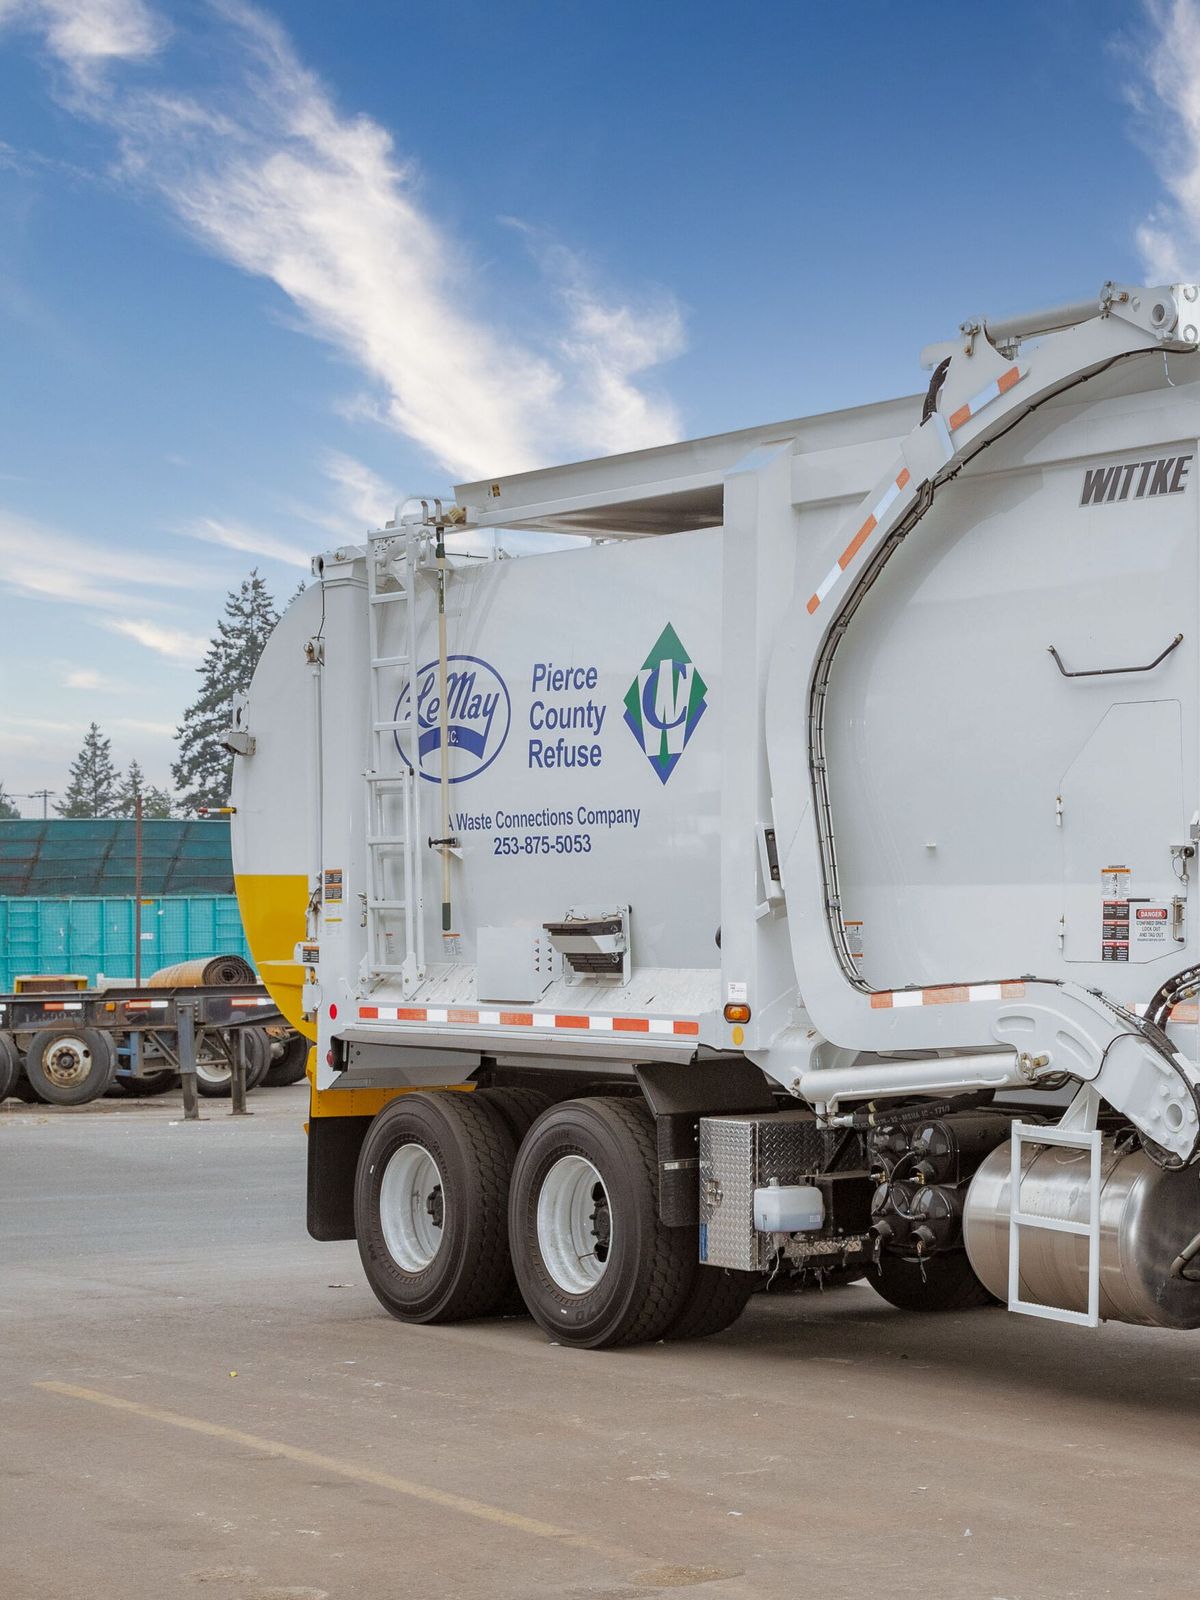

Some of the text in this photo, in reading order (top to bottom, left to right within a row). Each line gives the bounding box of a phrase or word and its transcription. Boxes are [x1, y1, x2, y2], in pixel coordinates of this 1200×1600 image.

[1081, 455, 1194, 506] WITTKE
[532, 663, 598, 692] Pierce
[529, 700, 607, 736] County
[528, 738, 602, 768] Refuse
[456, 813, 492, 831] Waste
[495, 808, 574, 829] Connections
[577, 806, 641, 828] Company
[494, 834, 592, 855] 253-875-5053
